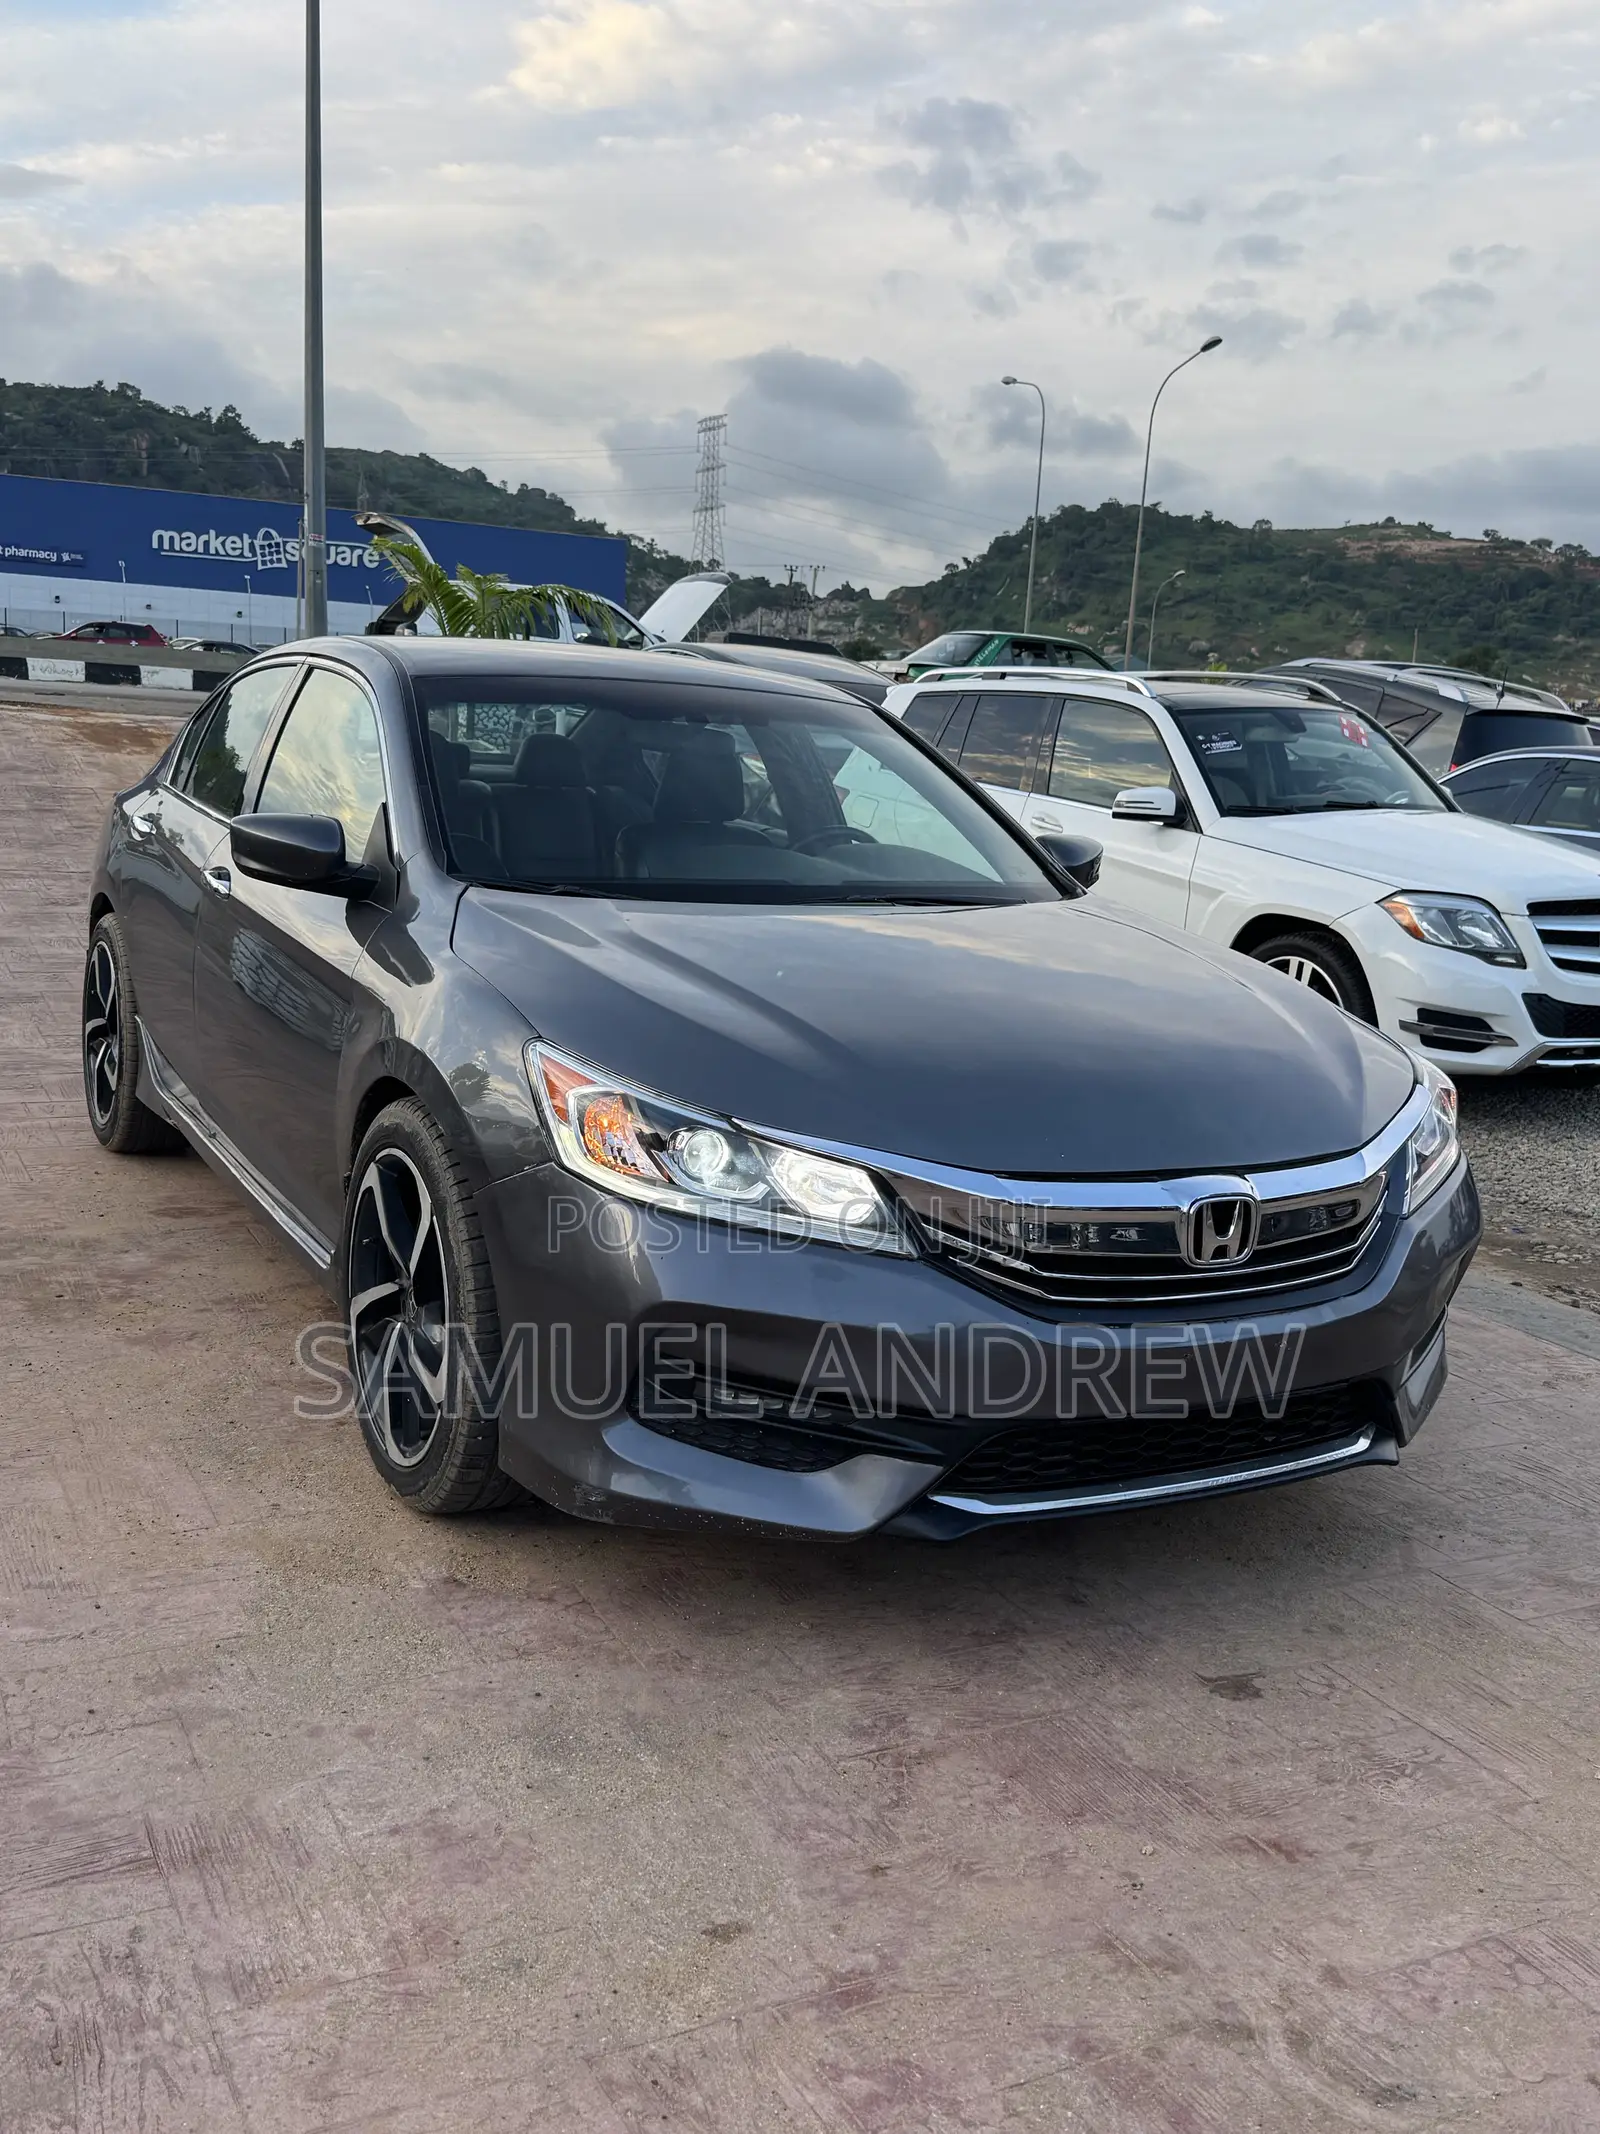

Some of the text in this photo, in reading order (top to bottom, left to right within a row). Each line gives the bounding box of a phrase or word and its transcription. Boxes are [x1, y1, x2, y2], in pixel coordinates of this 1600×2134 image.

[5, 546, 57, 562] pharmacy
[152, 529, 379, 569] market suare
